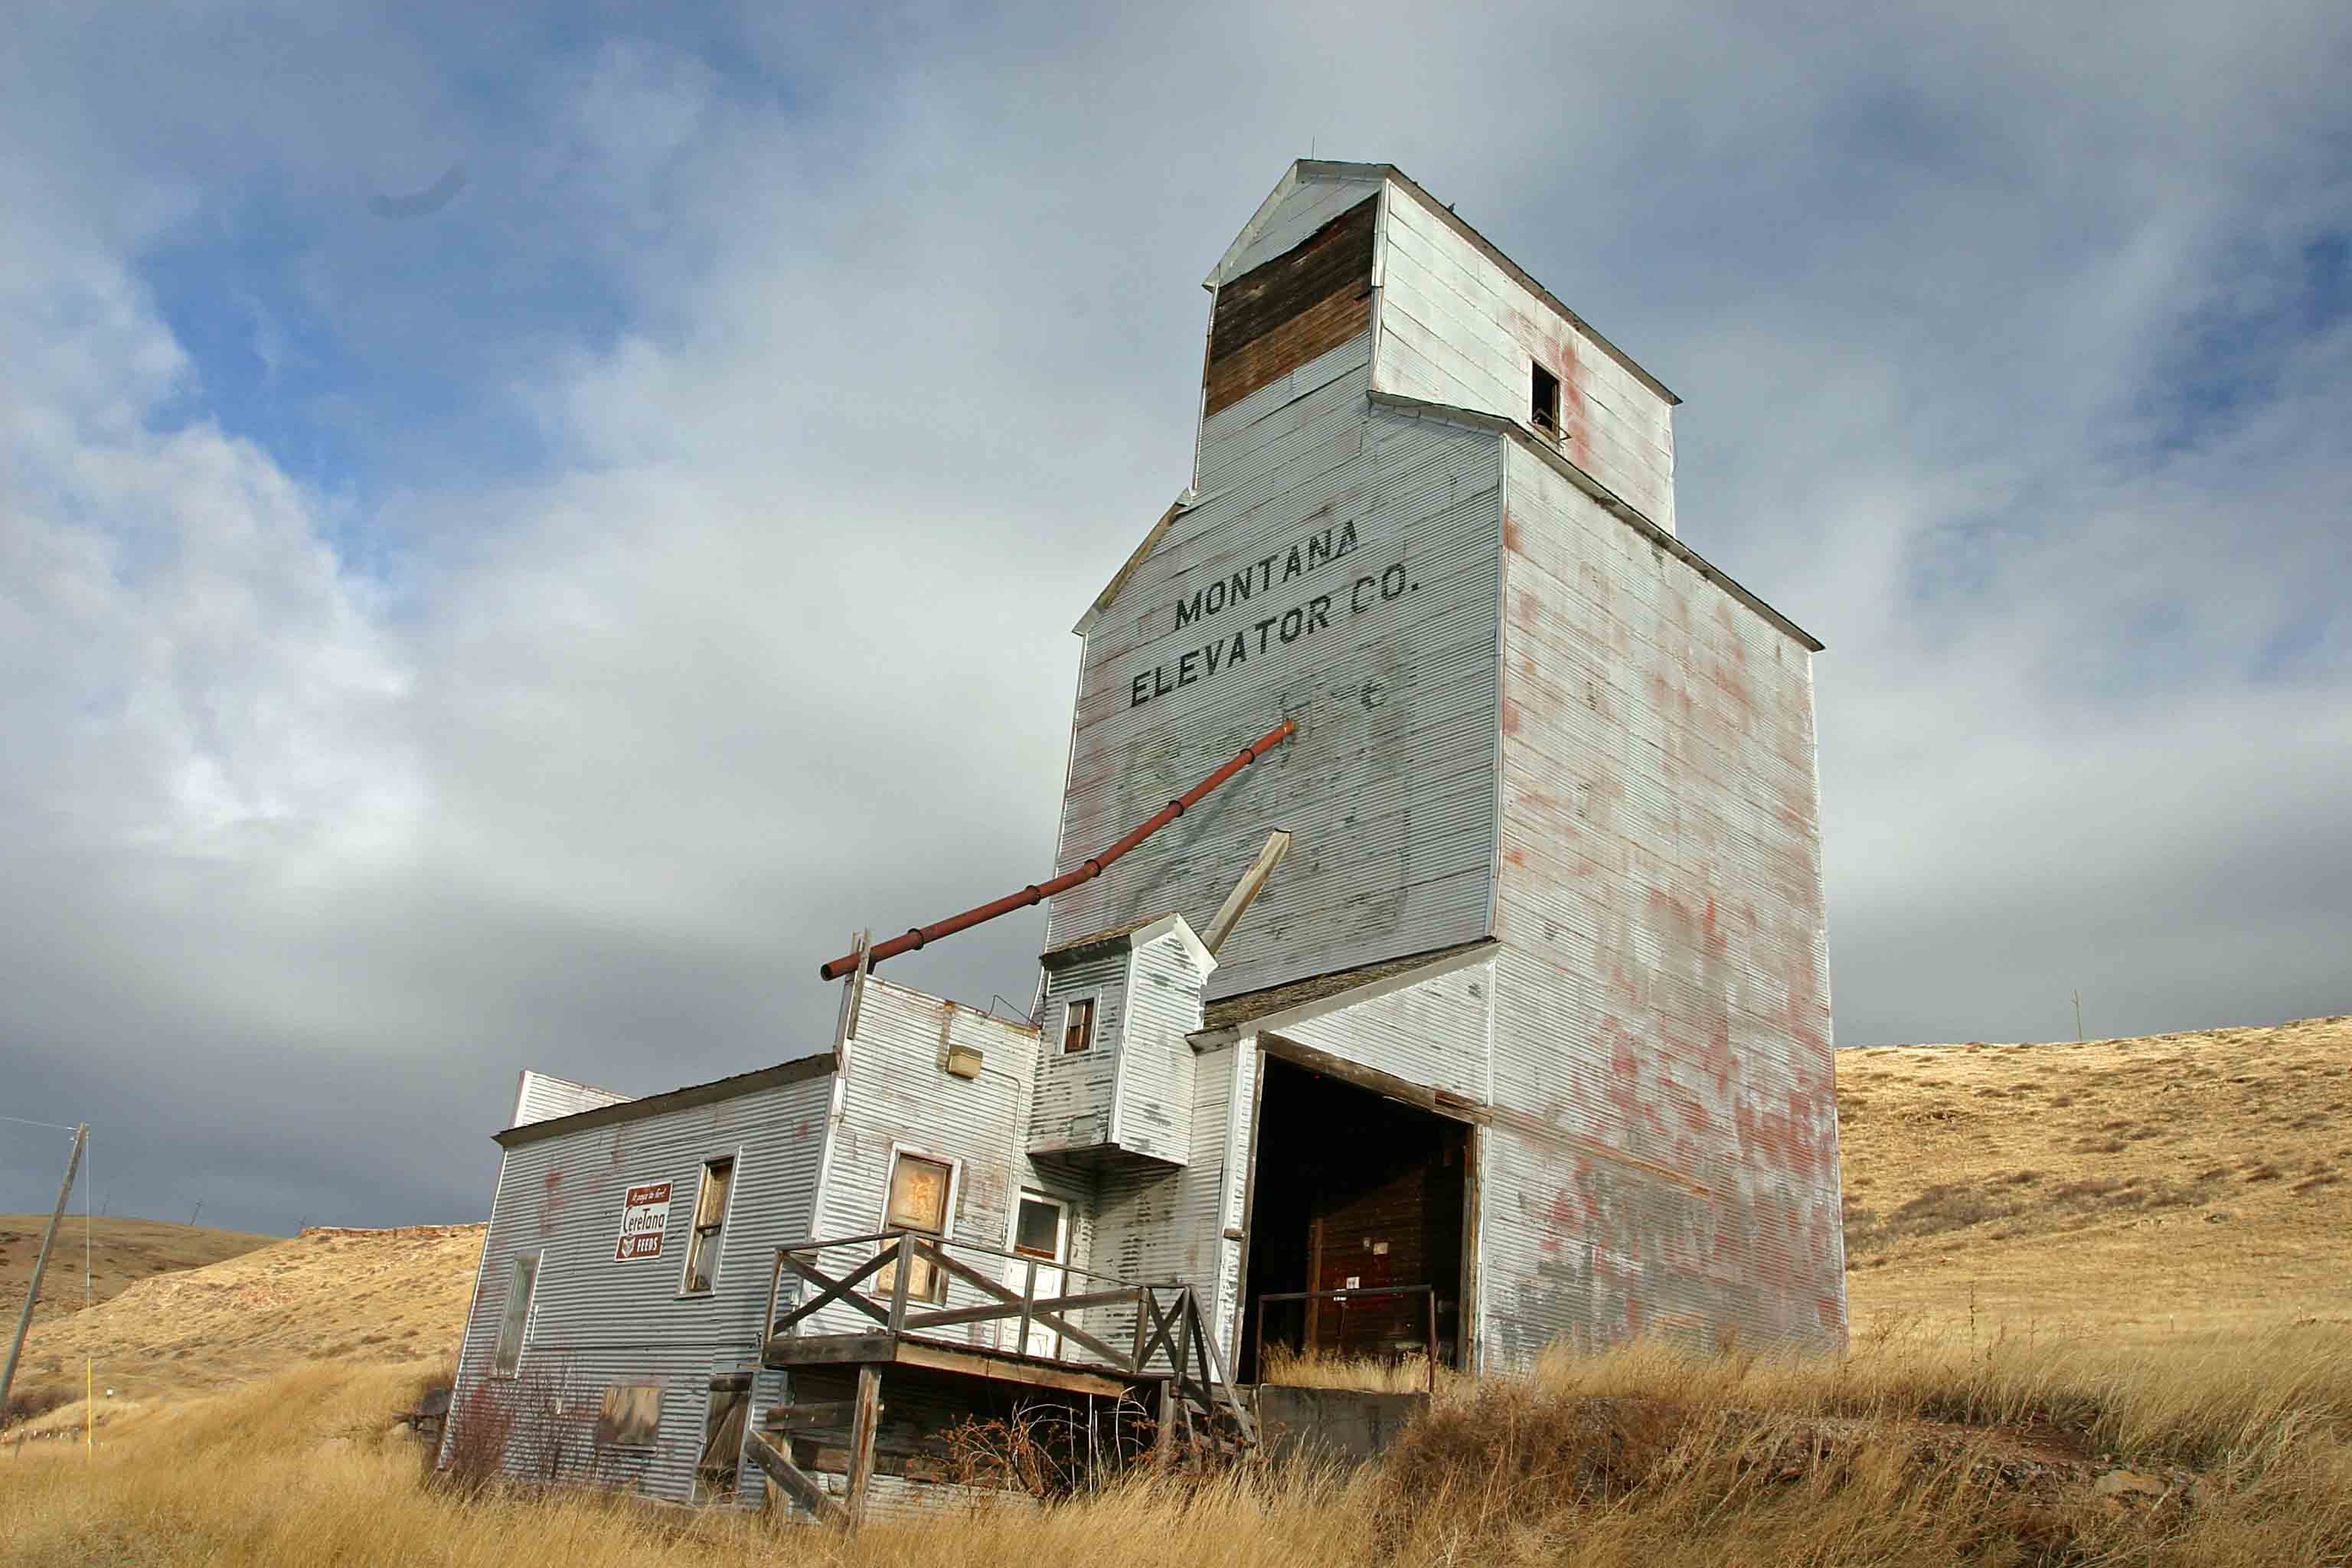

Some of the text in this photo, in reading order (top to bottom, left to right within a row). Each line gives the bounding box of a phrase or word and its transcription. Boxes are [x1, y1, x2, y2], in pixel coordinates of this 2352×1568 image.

[1174, 520, 1361, 631] MONTANA
[1129, 562, 1419, 707] ELEVATOR CO.
[623, 1205, 665, 1234] CereTana
[637, 1236, 658, 1253] FEEDS
